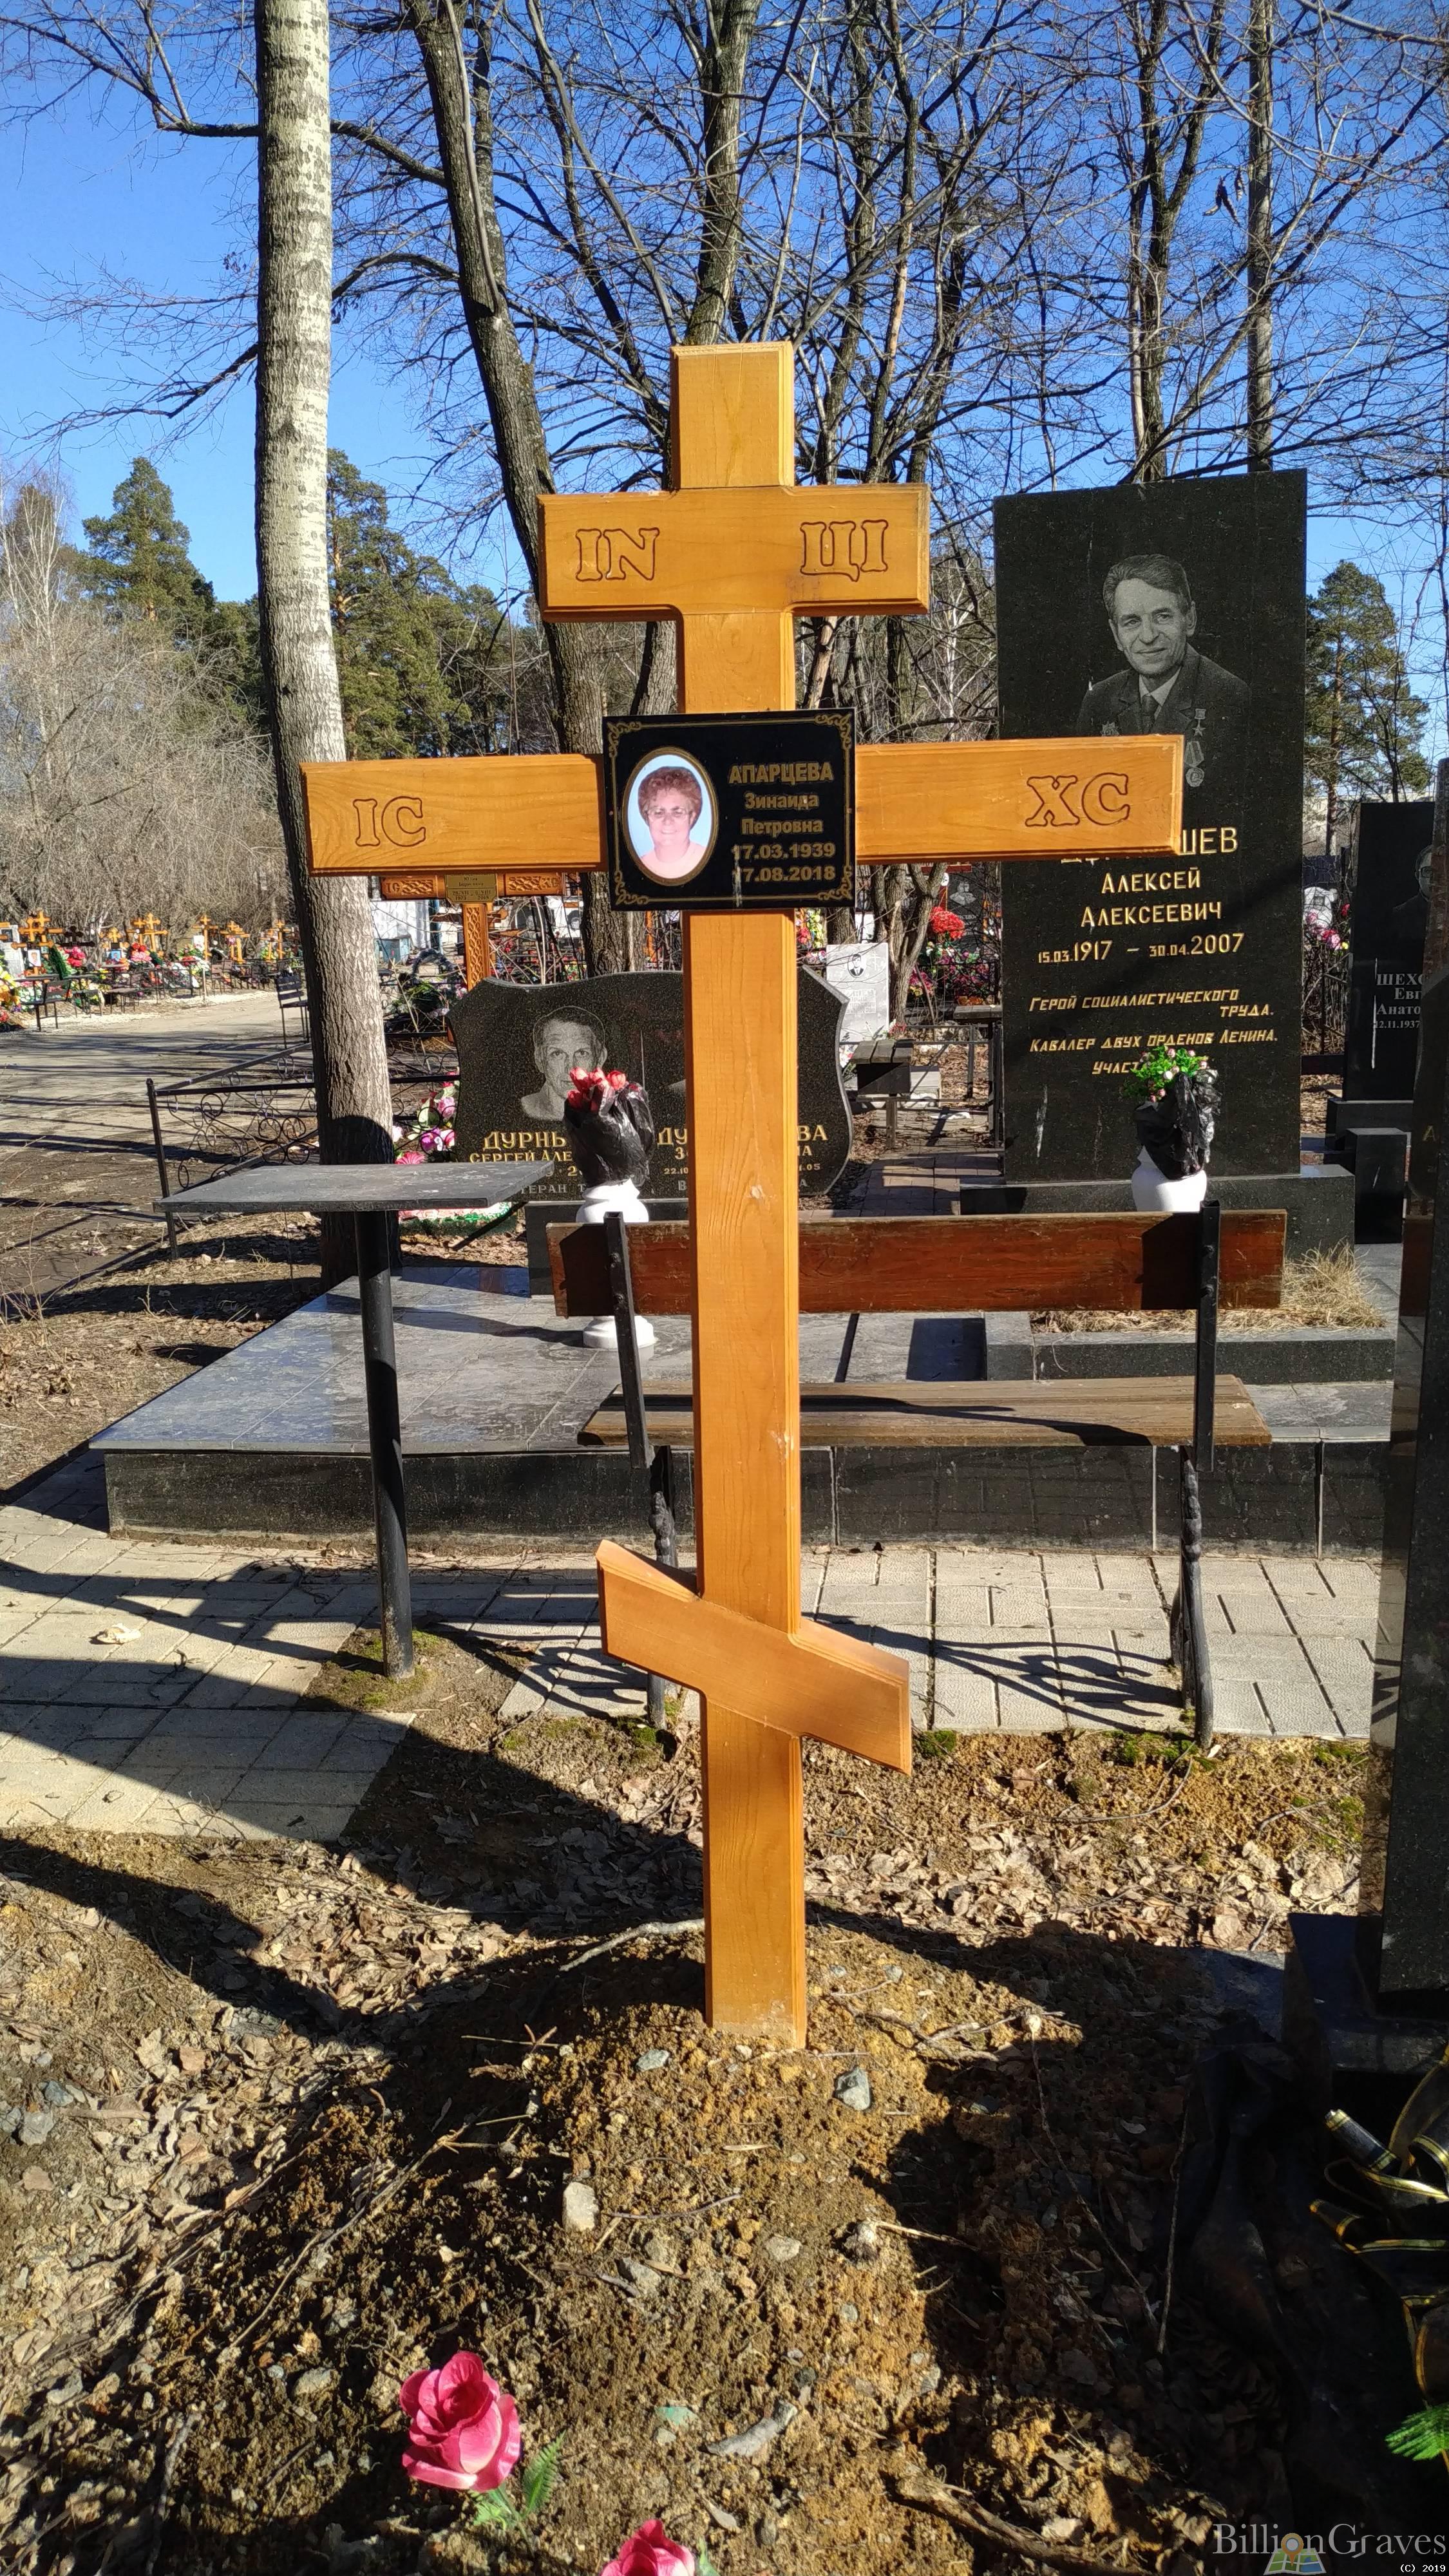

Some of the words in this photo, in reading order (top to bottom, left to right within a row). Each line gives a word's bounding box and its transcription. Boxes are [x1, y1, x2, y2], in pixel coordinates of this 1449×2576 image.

[728, 761, 834, 785] АПАРЦЕВА
[744, 791, 819, 810] Зинаида
[741, 817, 824, 838] Петровна
[731, 842, 836, 860] 17.03.1939
[1101, 867, 1200, 894] АЛЕКСЕЙ
[1081, 902, 1222, 927] АЛЕКСЕЕВИЧ
[1037, 940, 1113, 963] 15.03.1917
[1149, 933, 1245, 958] 30.04.2007
[1081, 989, 1240, 1009] СОЦИАЛИСТИЧЕСКОГО
[1220, 1003, 1274, 1018] ТРУДА.
[1030, 1037, 1096, 1052] КАВАЛЕР
[1101, 1035, 1142, 1049] ДВУХ
[1147, 1032, 1216, 1047] ОРДЕНОВ
[541, 1149, 573, 1162] АЛЕ
